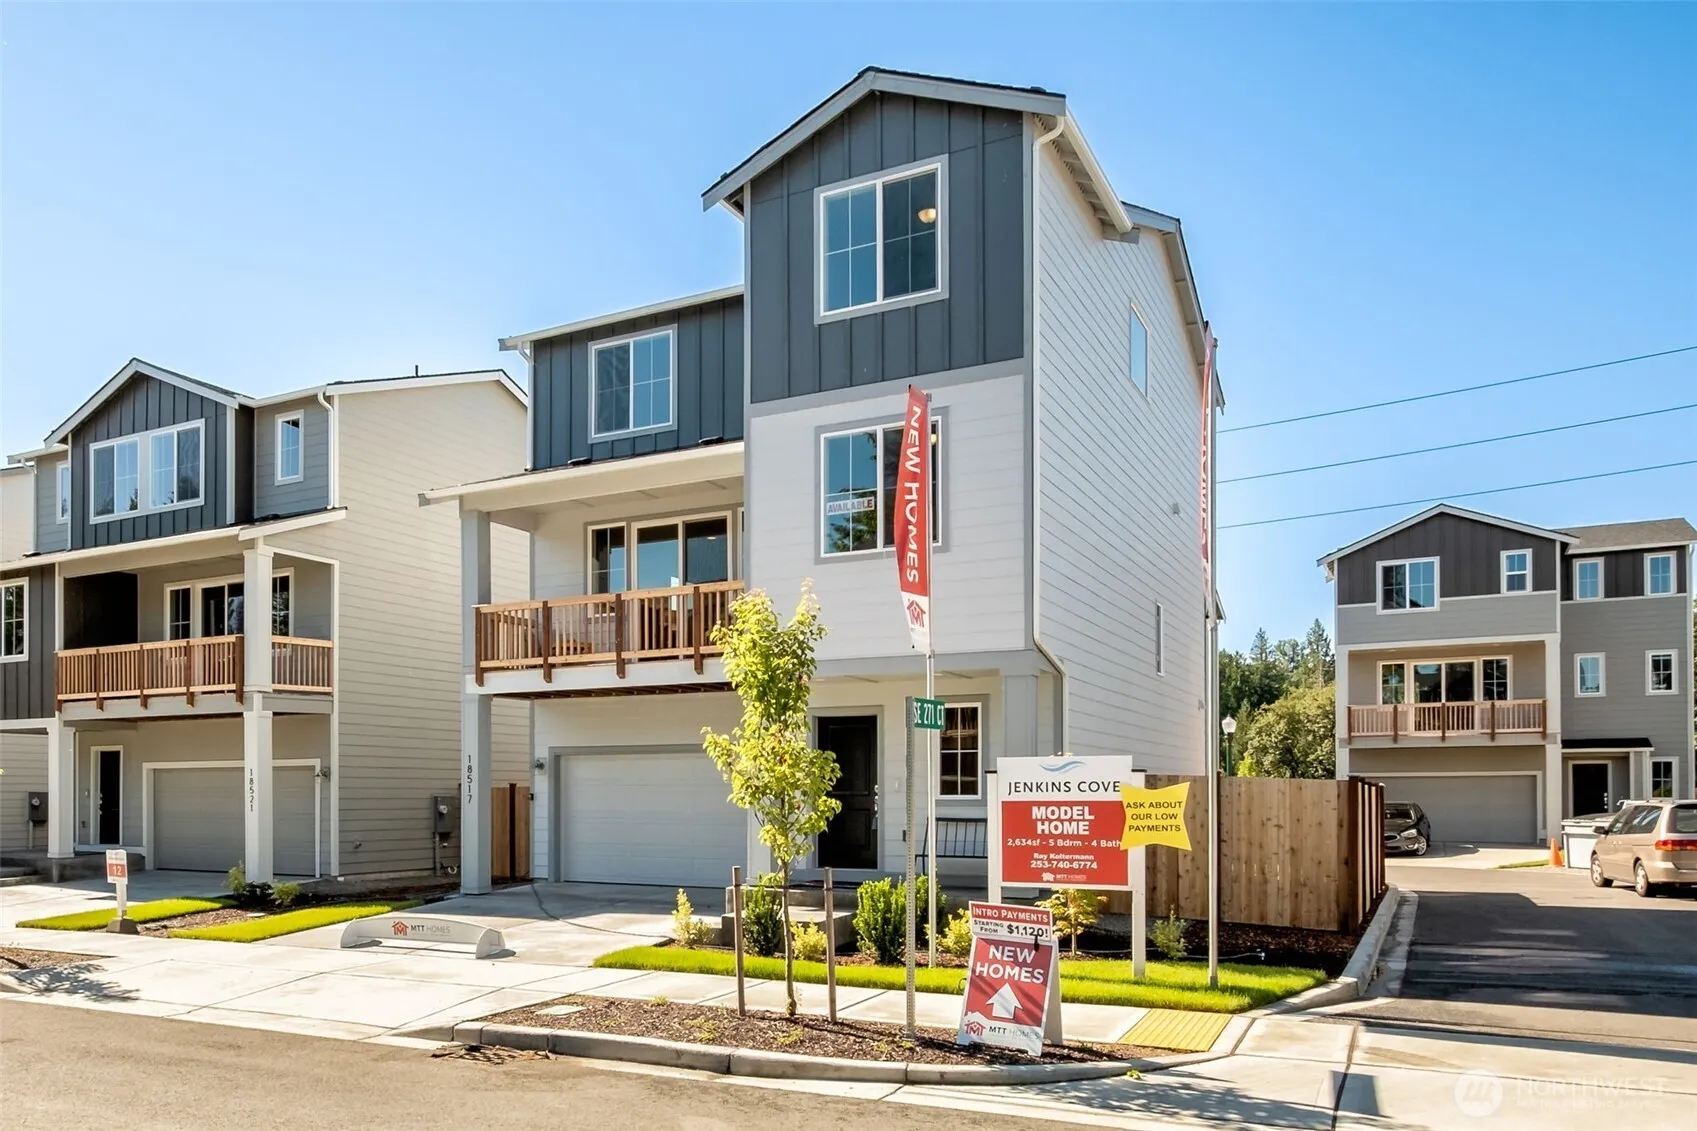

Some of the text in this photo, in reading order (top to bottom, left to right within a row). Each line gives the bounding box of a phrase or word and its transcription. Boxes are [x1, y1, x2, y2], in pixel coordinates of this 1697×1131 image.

[904, 405, 921, 584] NEW HOMES
[828, 500, 873, 513] AVAILABLE
[913, 702, 944, 725] SE 271 CT
[1008, 781, 1120, 795] JENKINS COVE
[1126, 801, 1183, 809] ASK ABOUT
[1032, 806, 1094, 819] MODEL
[1037, 821, 1089, 834] HOME
[1128, 824, 1181, 832] PAYMENTS
[1007, 838, 1040, 847] 2,634sf
[1057, 839, 1082, 847] Bdrm
[113, 865, 122, 876] 12
[1031, 861, 1098, 869] 253-740-6774
[973, 906, 1048, 923] INTRO PAYMENTS
[411, 924, 451, 933] MTT HOMES
[974, 919, 1004, 928] STARTING
[1007, 923, 1048, 938] $1,120!
[988, 944, 1036, 964] NEW
[975, 961, 1044, 984] HOMES
[988, 1026, 1007, 1035] MTT
[1008, 1030, 1040, 1039] HOMES
